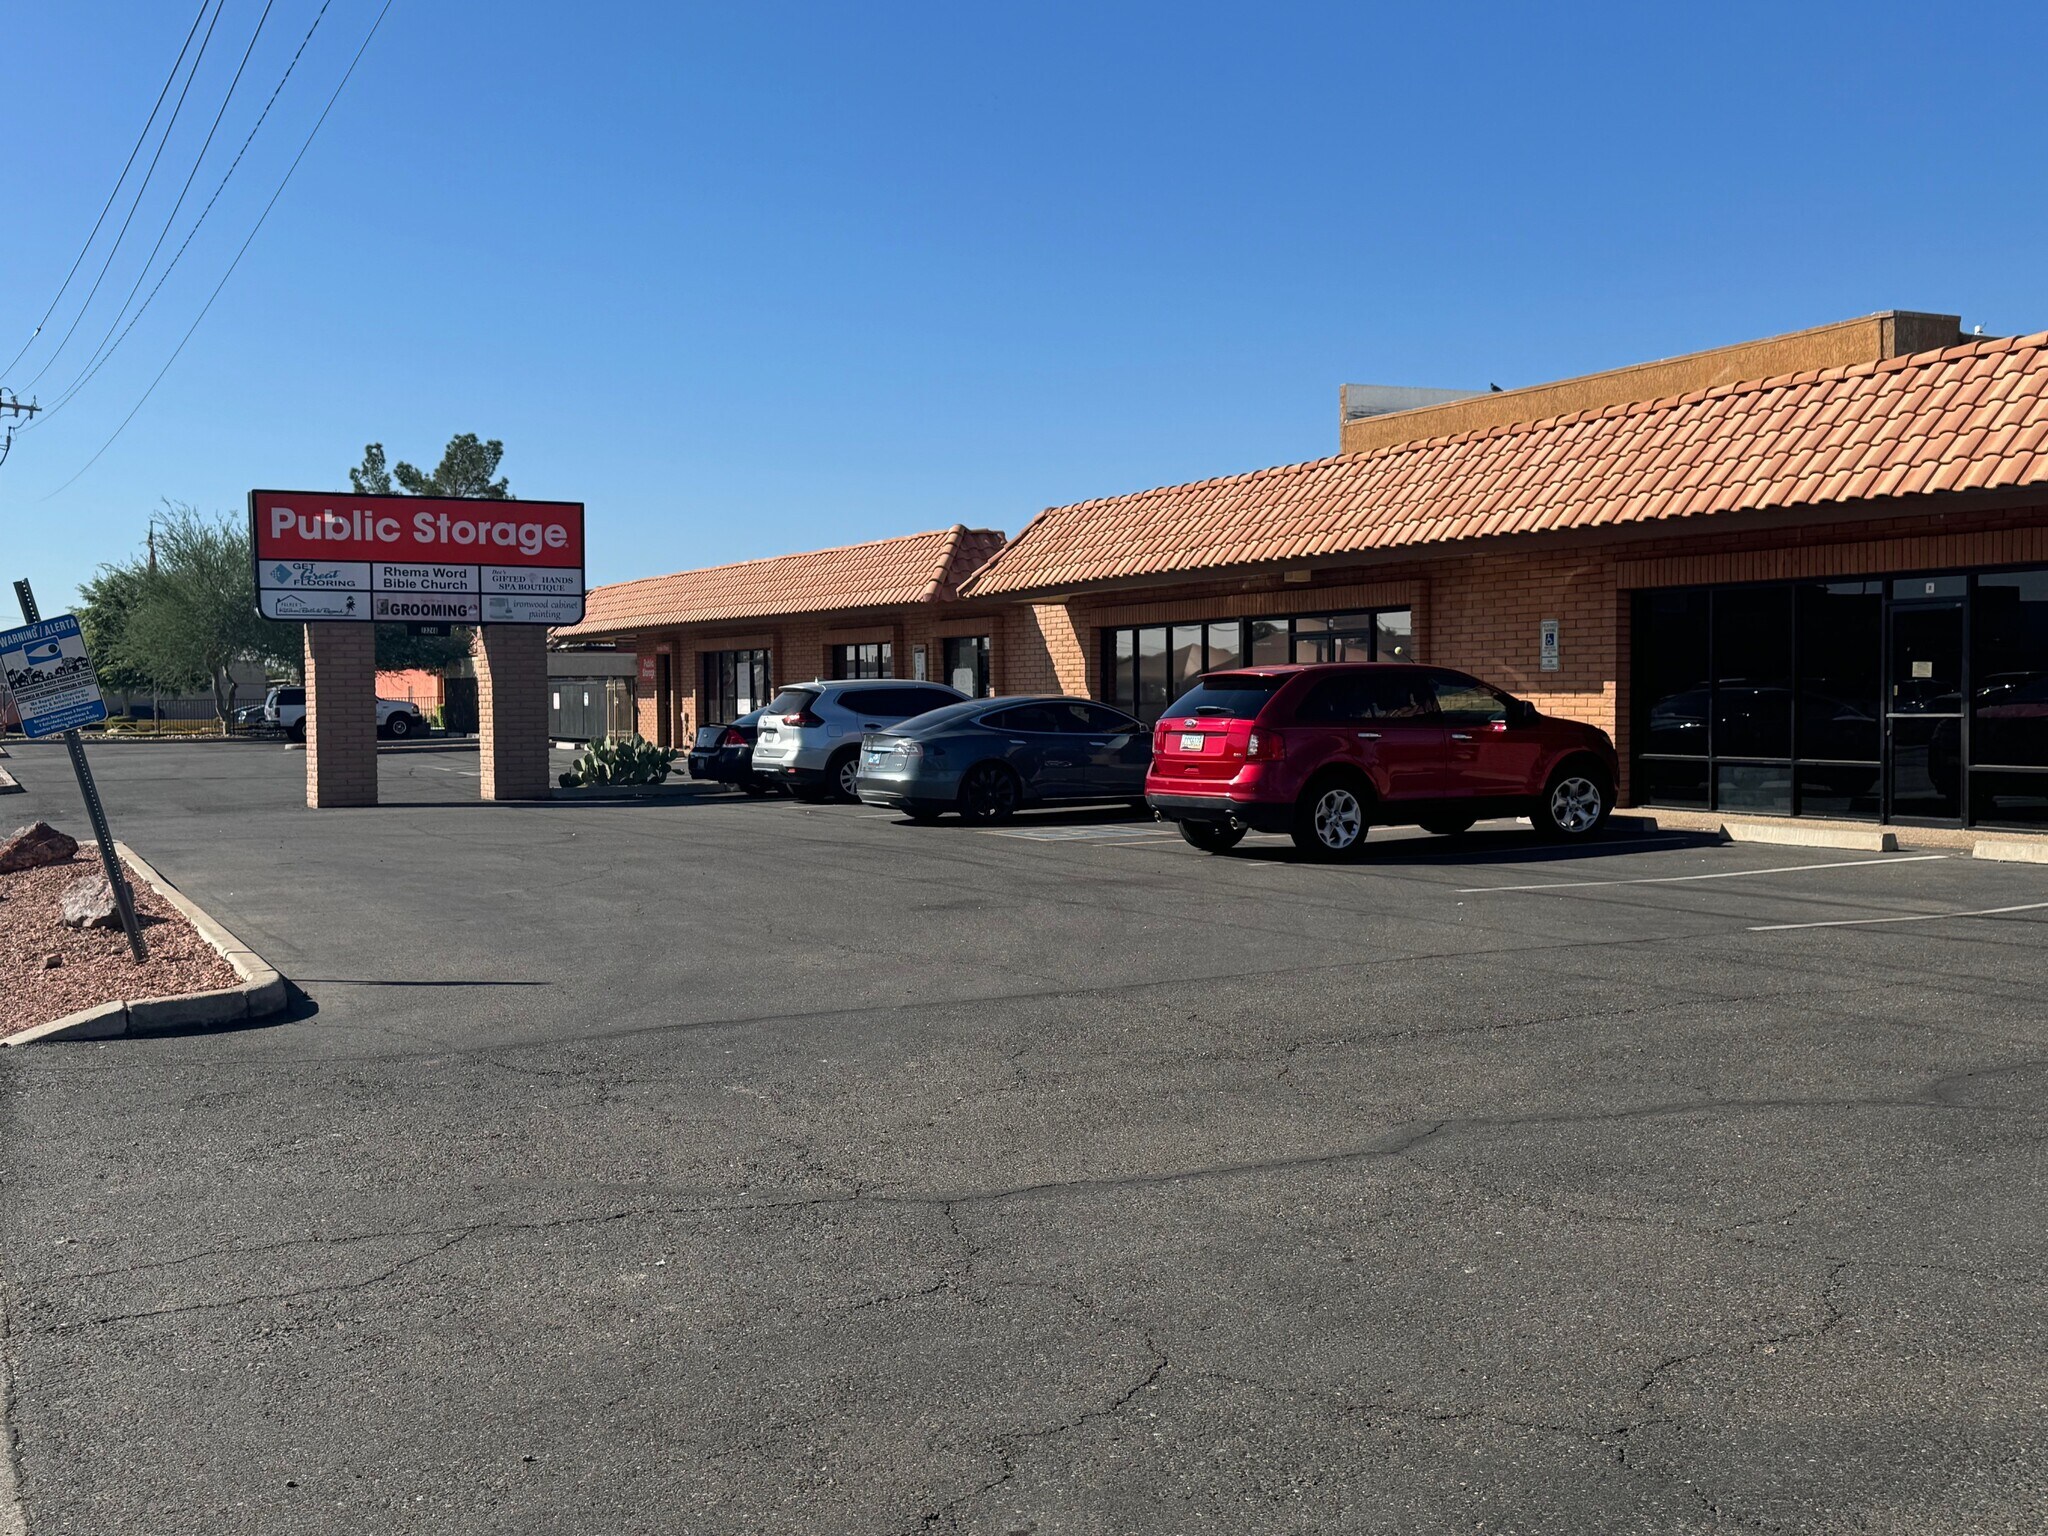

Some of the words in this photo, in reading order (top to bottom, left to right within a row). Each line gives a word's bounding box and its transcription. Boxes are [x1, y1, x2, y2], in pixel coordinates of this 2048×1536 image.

[270, 507, 401, 543] Public
[413, 511, 568, 556] Storage
[300, 568, 341, 581] Great
[383, 566, 429, 577] Rhema
[432, 568, 467, 578] Word
[293, 579, 356, 587] FLOORING
[383, 578, 416, 588] Bible
[421, 579, 468, 590] Church
[542, 576, 574, 584] HANDS
[518, 583, 566, 592] BOUTIQUE
[390, 603, 467, 617] GROOMING
[513, 599, 548, 608] ironwood
[551, 600, 578, 609] cabinet
[529, 609, 561, 621] painting
[0, 628, 38, 648] WARNING
[44, 618, 77, 636] ALERTA
